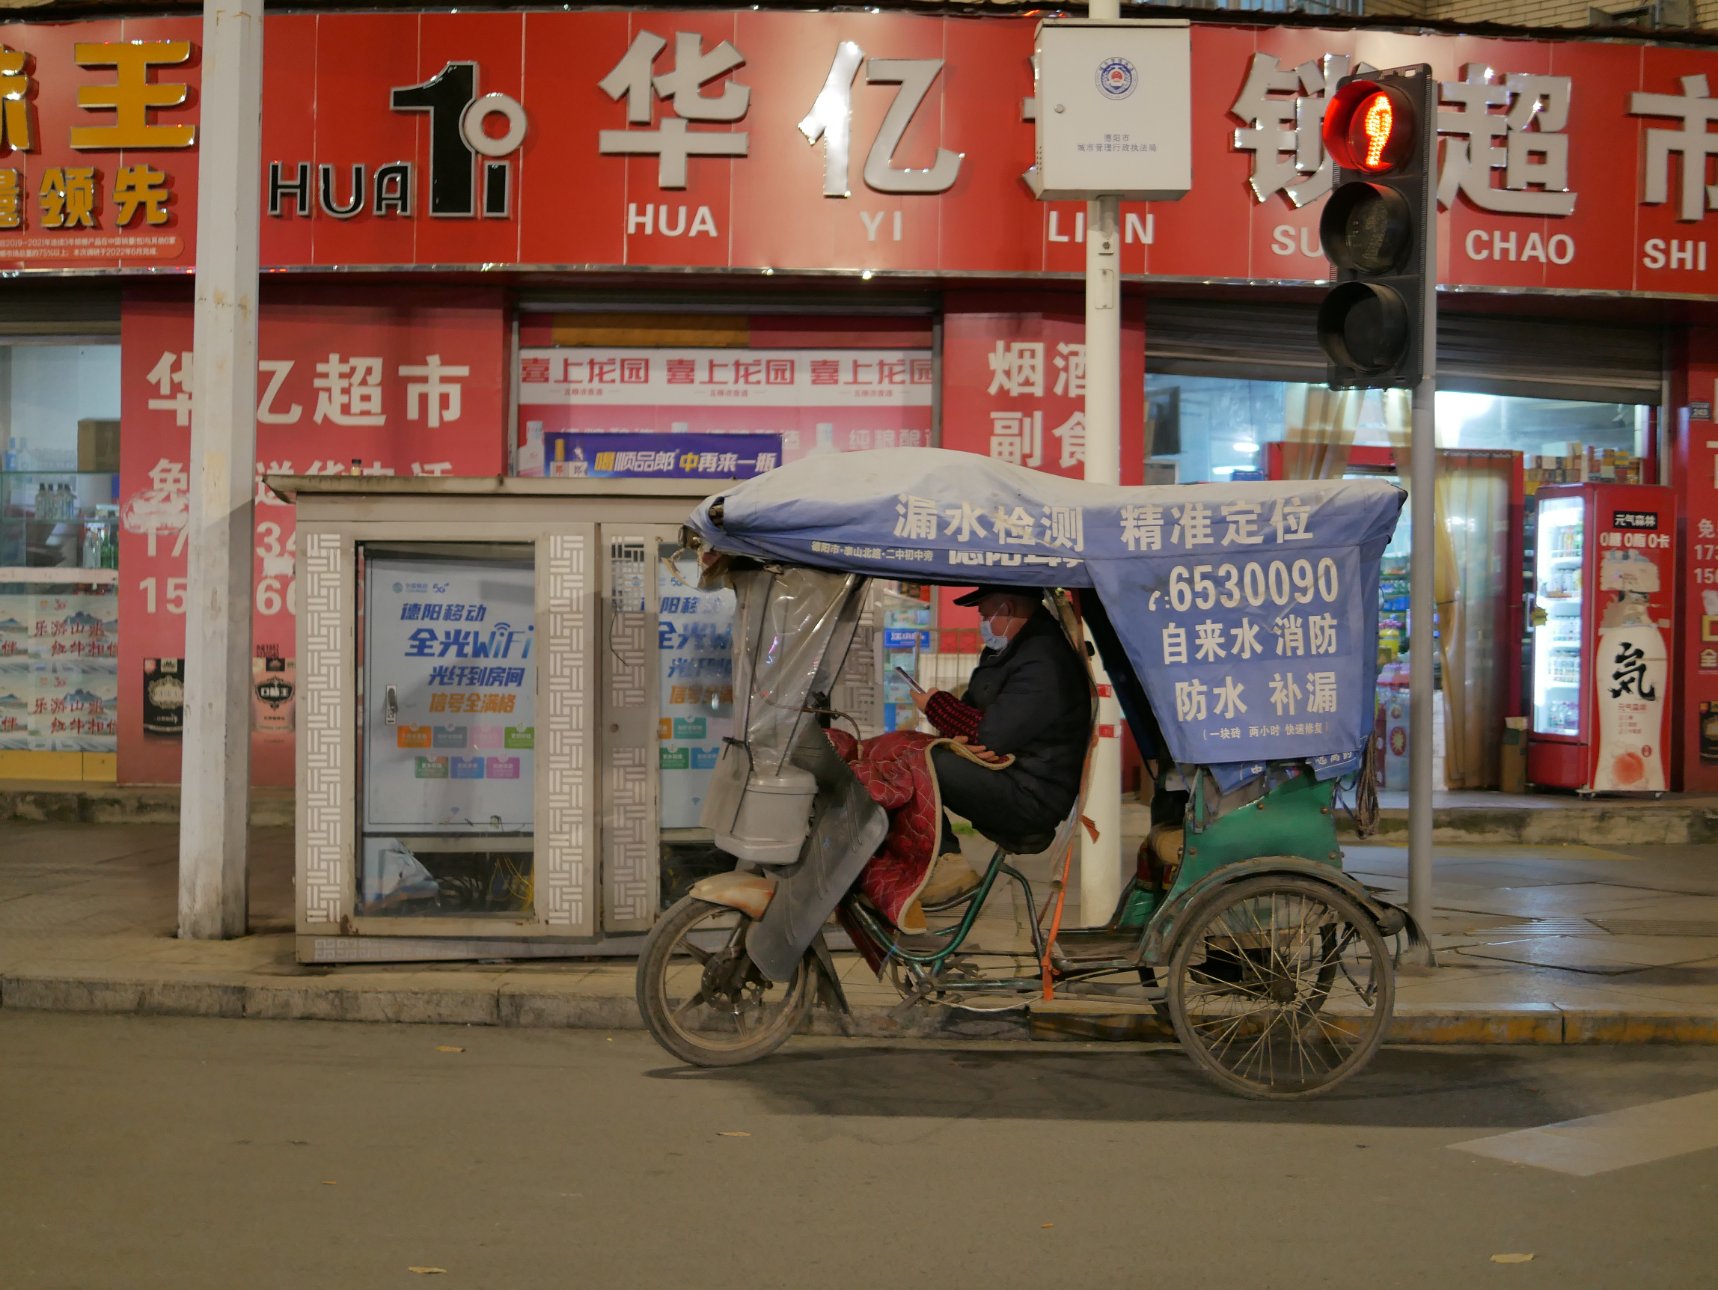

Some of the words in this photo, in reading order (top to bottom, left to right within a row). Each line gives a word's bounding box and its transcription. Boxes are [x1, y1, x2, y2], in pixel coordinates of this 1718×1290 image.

[0, 41, 195, 149] 王
[597, 30, 1718, 222] 华亿锁超市
[626, 203, 719, 237] HUA
[859, 211, 903, 241] YI
[1047, 210, 1155, 244] LIN
[1271, 225, 1325, 259] SU
[1465, 231, 1576, 264] CHAO
[1643, 239, 1708, 272] SHI
[893, 493, 1084, 552] 漏水检测
[1120, 497, 1314, 551] 精准定位
[400, 602, 488, 622] 德阳移动
[1162, 617, 1264, 664] 自来水
[1274, 613, 1338, 656] 消防
[428, 665, 525, 687] 光纤到房间
[1175, 676, 1248, 722] 防水
[1269, 671, 1337, 716] 补漏
[1248, 724, 1280, 737] 两小时
